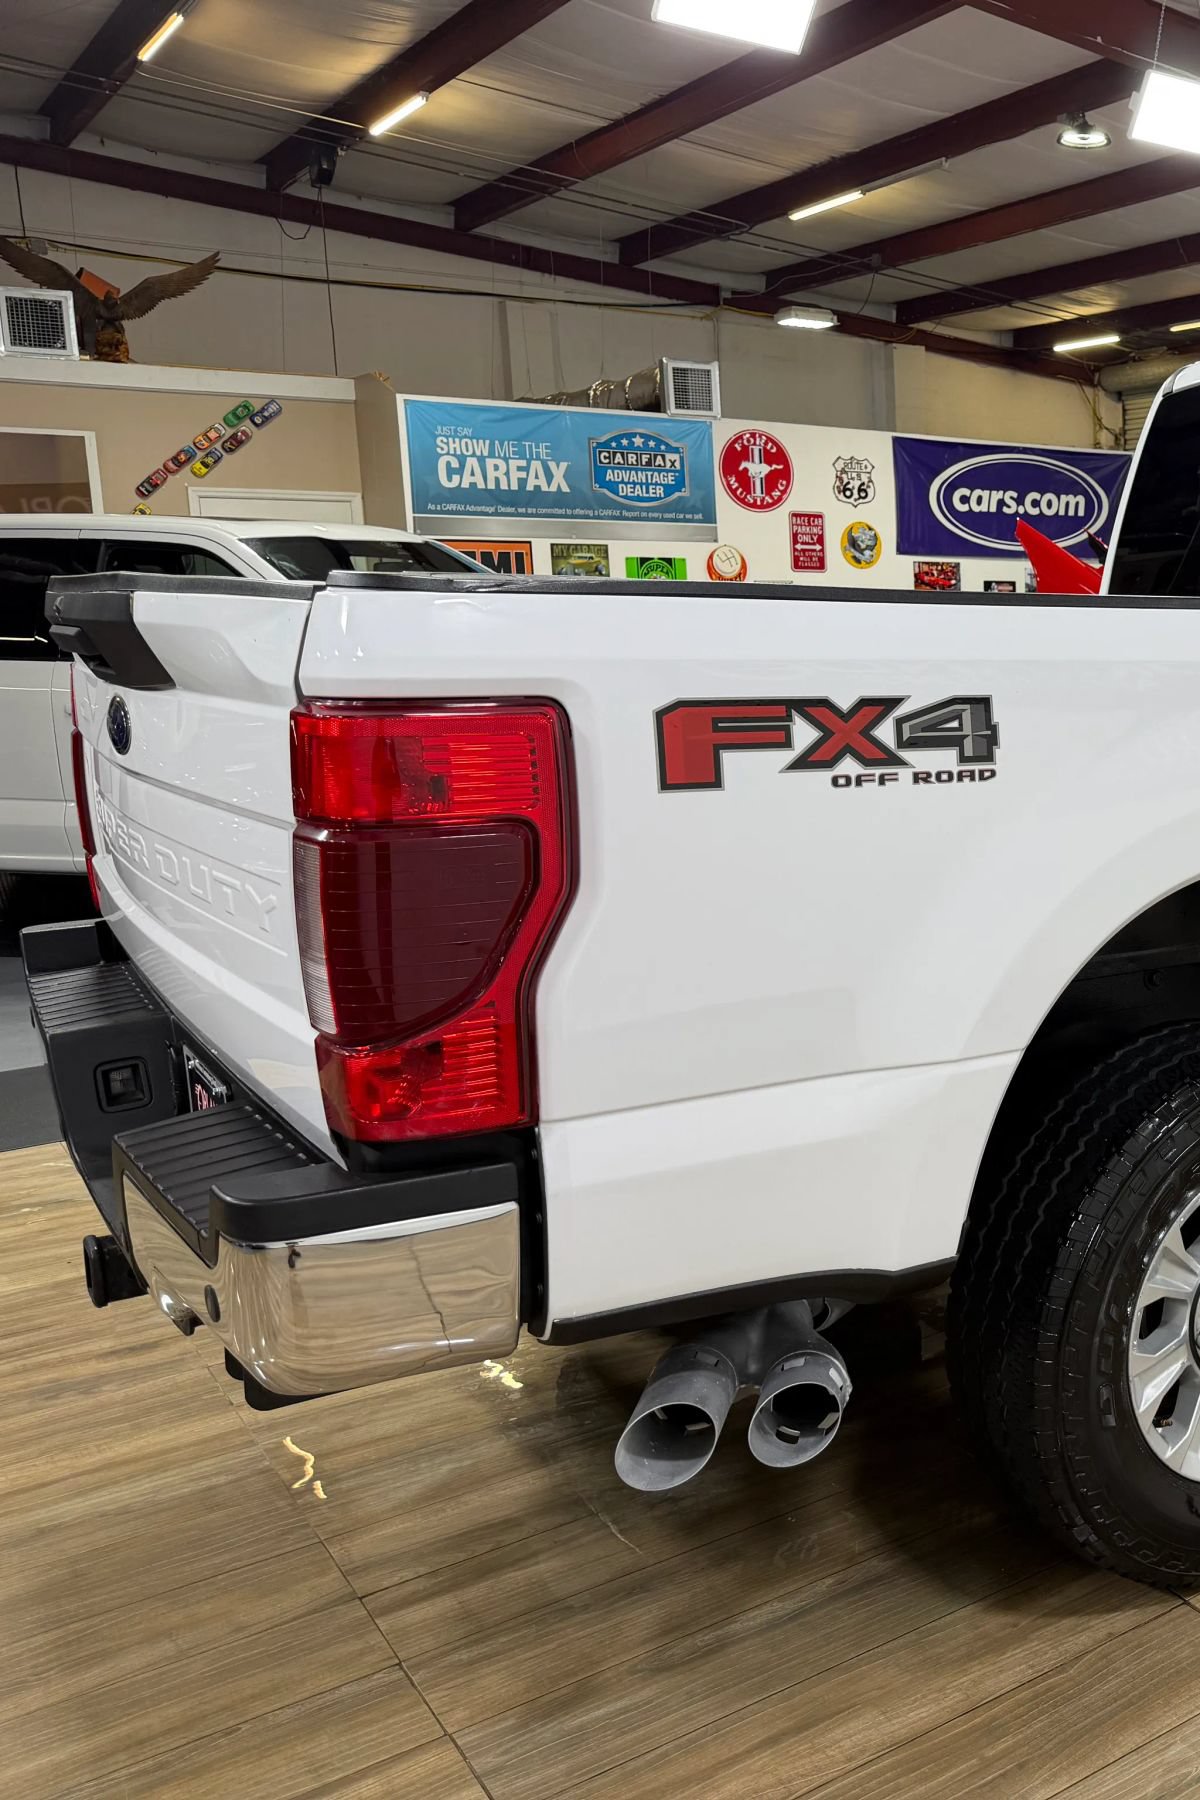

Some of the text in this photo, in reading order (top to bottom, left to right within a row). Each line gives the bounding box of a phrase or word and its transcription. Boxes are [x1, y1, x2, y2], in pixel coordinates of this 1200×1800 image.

[435, 425, 473, 437] JUST SAY
[436, 436, 553, 460] SHOW ME THE
[734, 433, 777, 453] FORD
[599, 451, 678, 469] CARFAX
[843, 461, 864, 471] ROUTE
[437, 454, 571, 493] CARFAX
[605, 469, 676, 485] ADVANTAGE
[618, 483, 665, 498] DEALER
[727, 474, 787, 506] MUSTANG
[952, 487, 1086, 517] cars.com
[441, 503, 465, 512] CARFAX
[537, 507, 566, 515] committed
[572, 508, 594, 517] offering
[599, 508, 621, 517] CARFAX
[622, 509, 640, 519] Report
[648, 511, 662, 520] every
[792, 516, 823, 526] RACE CAR
[792, 525, 823, 535] PARKING
[797, 534, 818, 543] ONLY
[552, 544, 607, 558] MY GARAGE
[644, 563, 671, 575] SUPER
[653, 695, 1000, 793] FX4
[831, 767, 997, 789] OFF ROAD
[153, 842, 277, 933] DUTY
